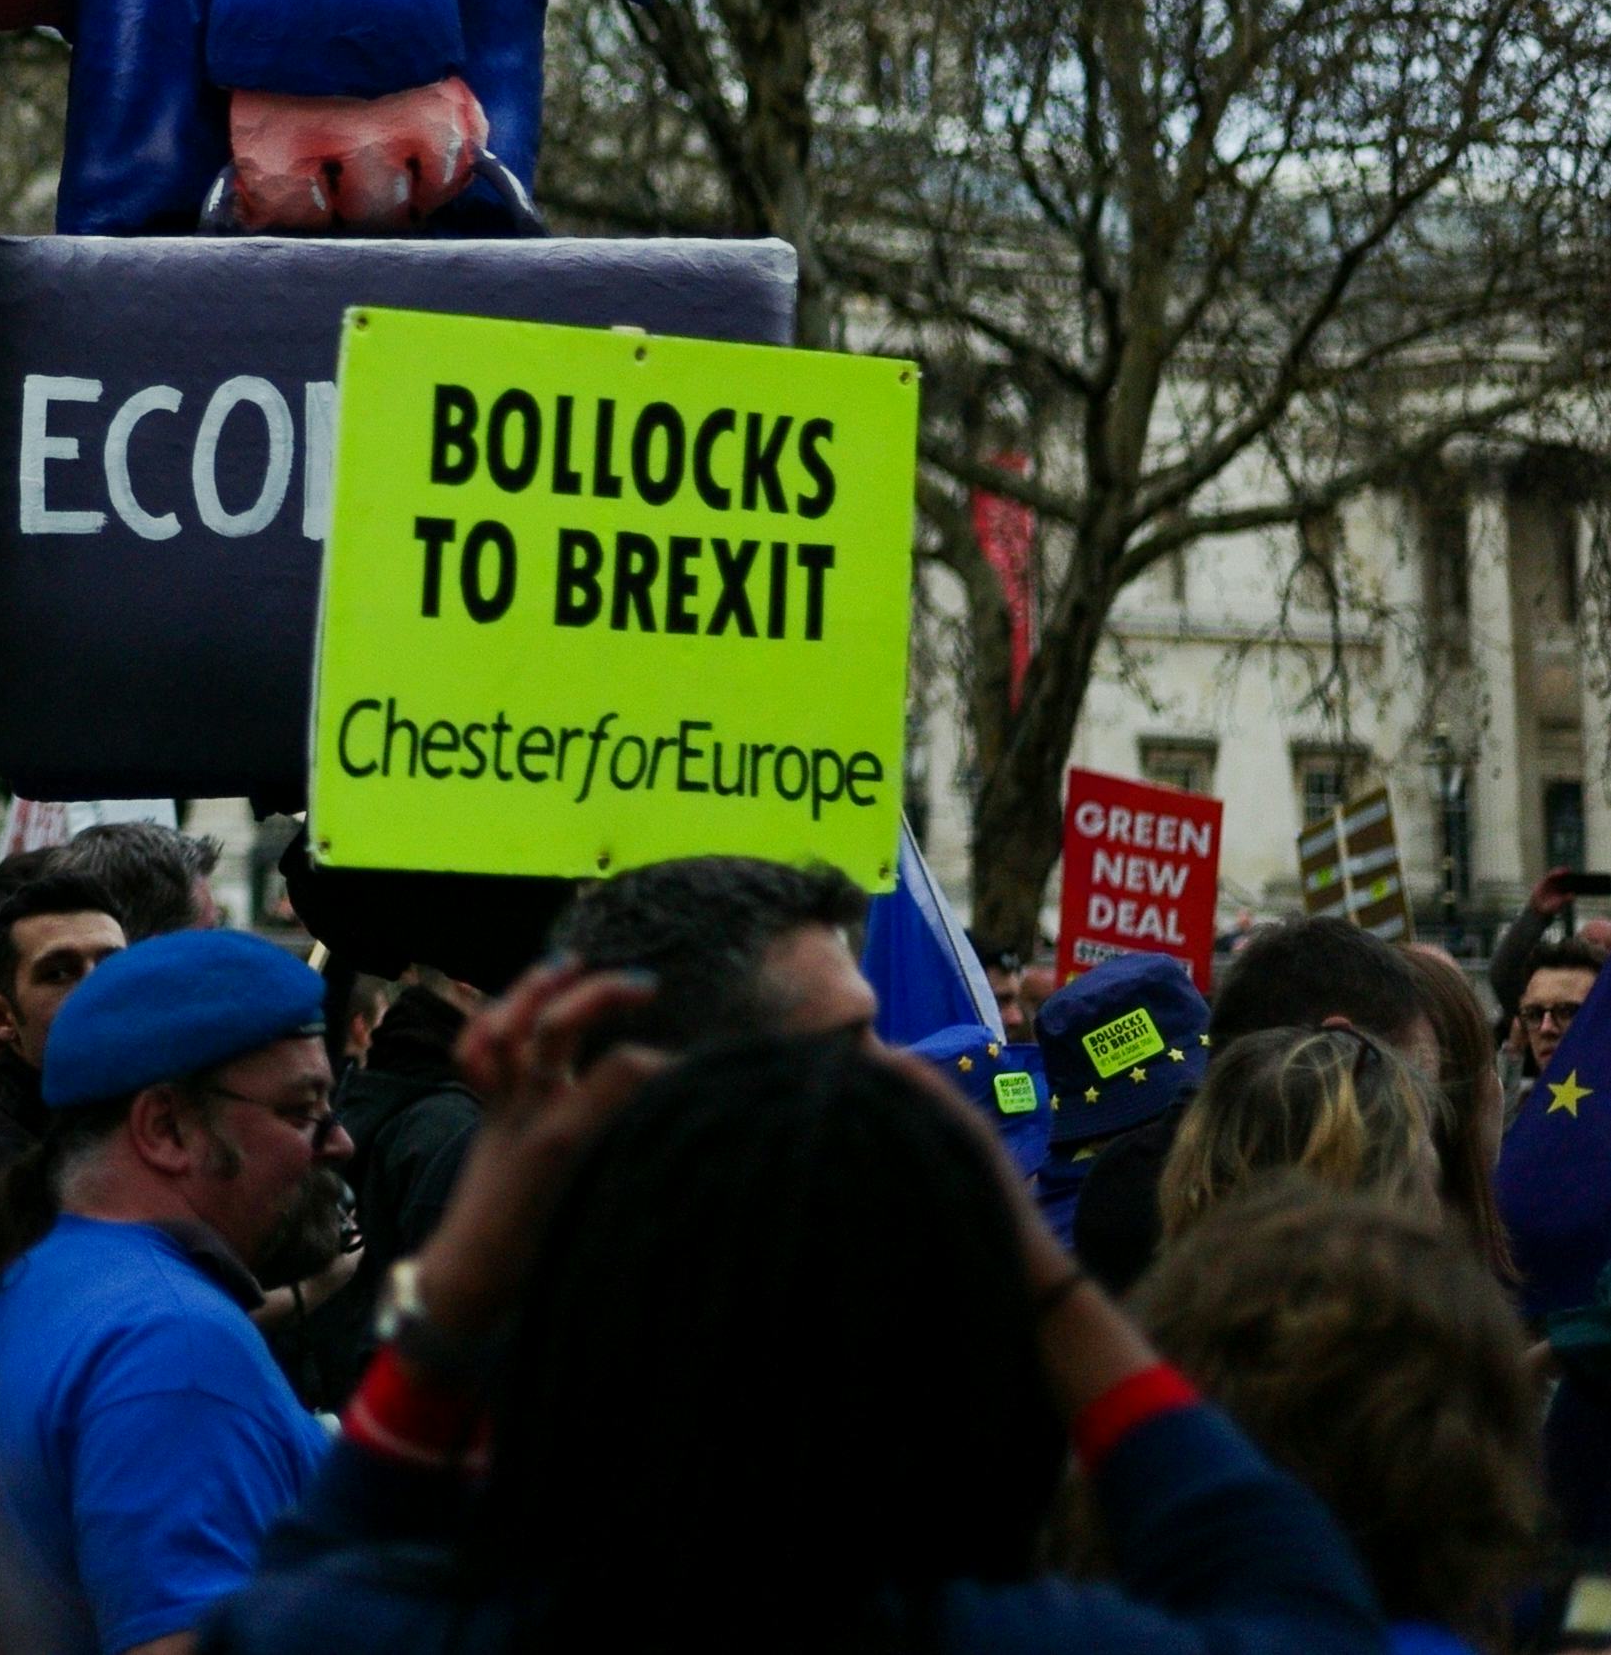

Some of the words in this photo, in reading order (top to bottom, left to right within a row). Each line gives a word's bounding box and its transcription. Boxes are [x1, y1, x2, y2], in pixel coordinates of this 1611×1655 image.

[431, 383, 836, 519] BOLLOCKS
[414, 516, 517, 624] TO
[554, 527, 835, 641] BREXIT
[338, 697, 884, 821] ChesterforEurope
[1074, 800, 1212, 858] GREEN
[1091, 848, 1190, 899] NEW
[1087, 893, 1186, 945] DEAL
[1089, 1013, 1143, 1047] BOLLOCKS
[1093, 1044, 1108, 1057] TO
[1110, 1023, 1149, 1049] BREXIT
